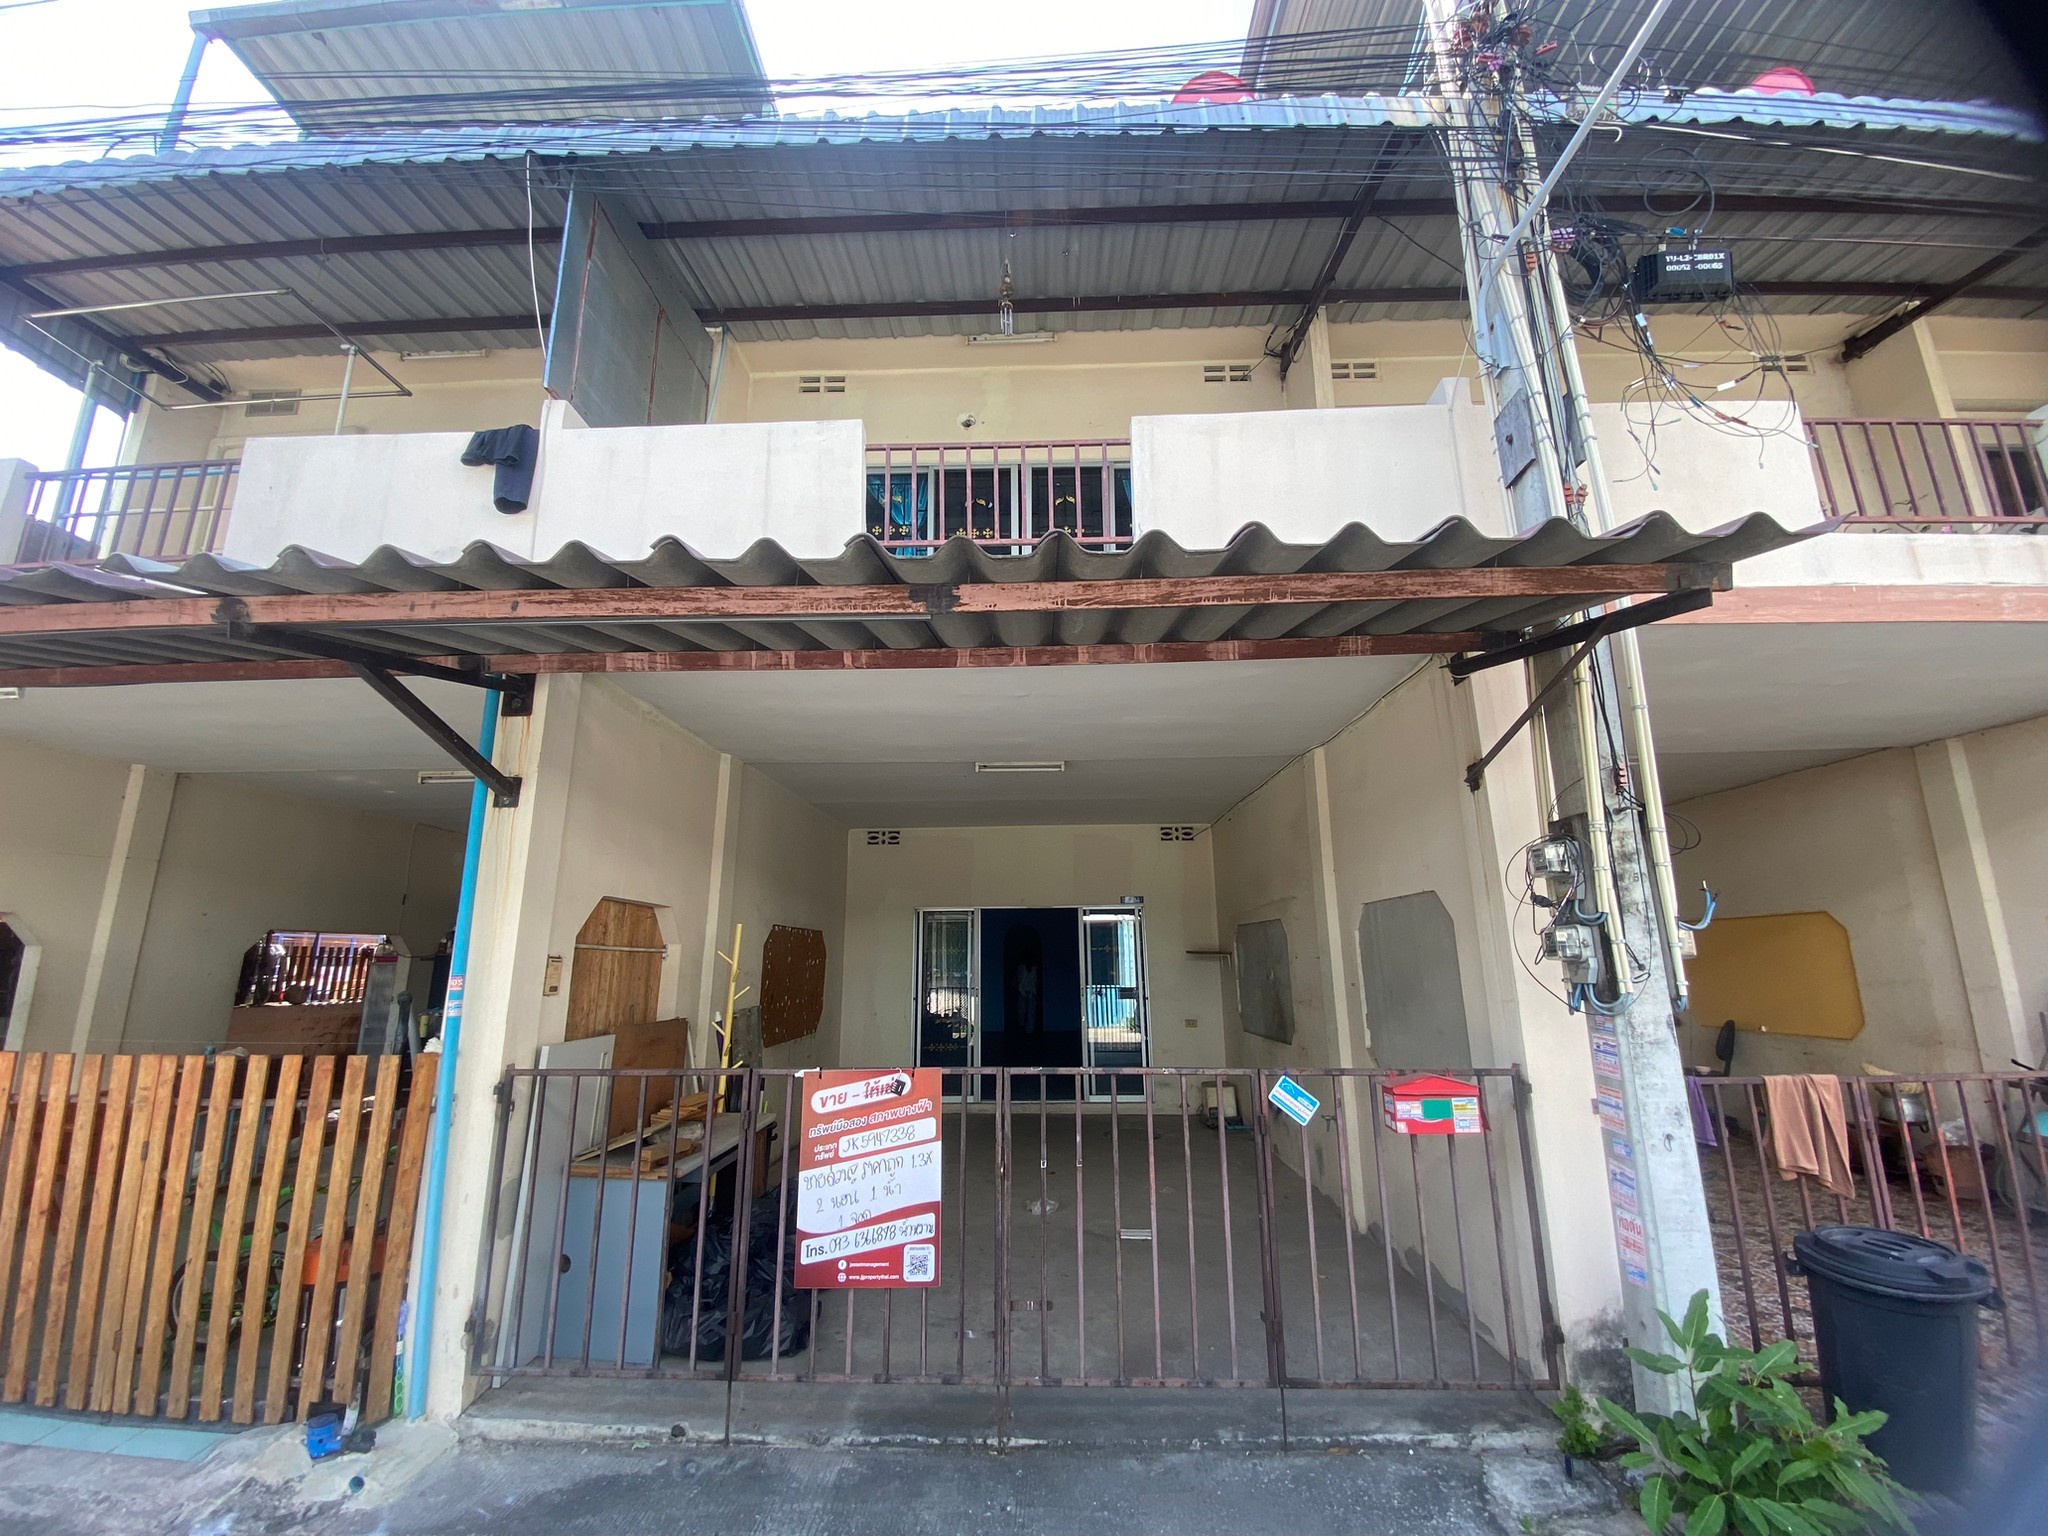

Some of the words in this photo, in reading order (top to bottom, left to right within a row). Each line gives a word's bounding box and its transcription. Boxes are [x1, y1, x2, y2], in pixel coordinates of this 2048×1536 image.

[819, 1091, 848, 1109] ขาย
[809, 1116, 867, 1138] ทรัพย์มือสอง
[805, 1244, 828, 1258] โทร.
